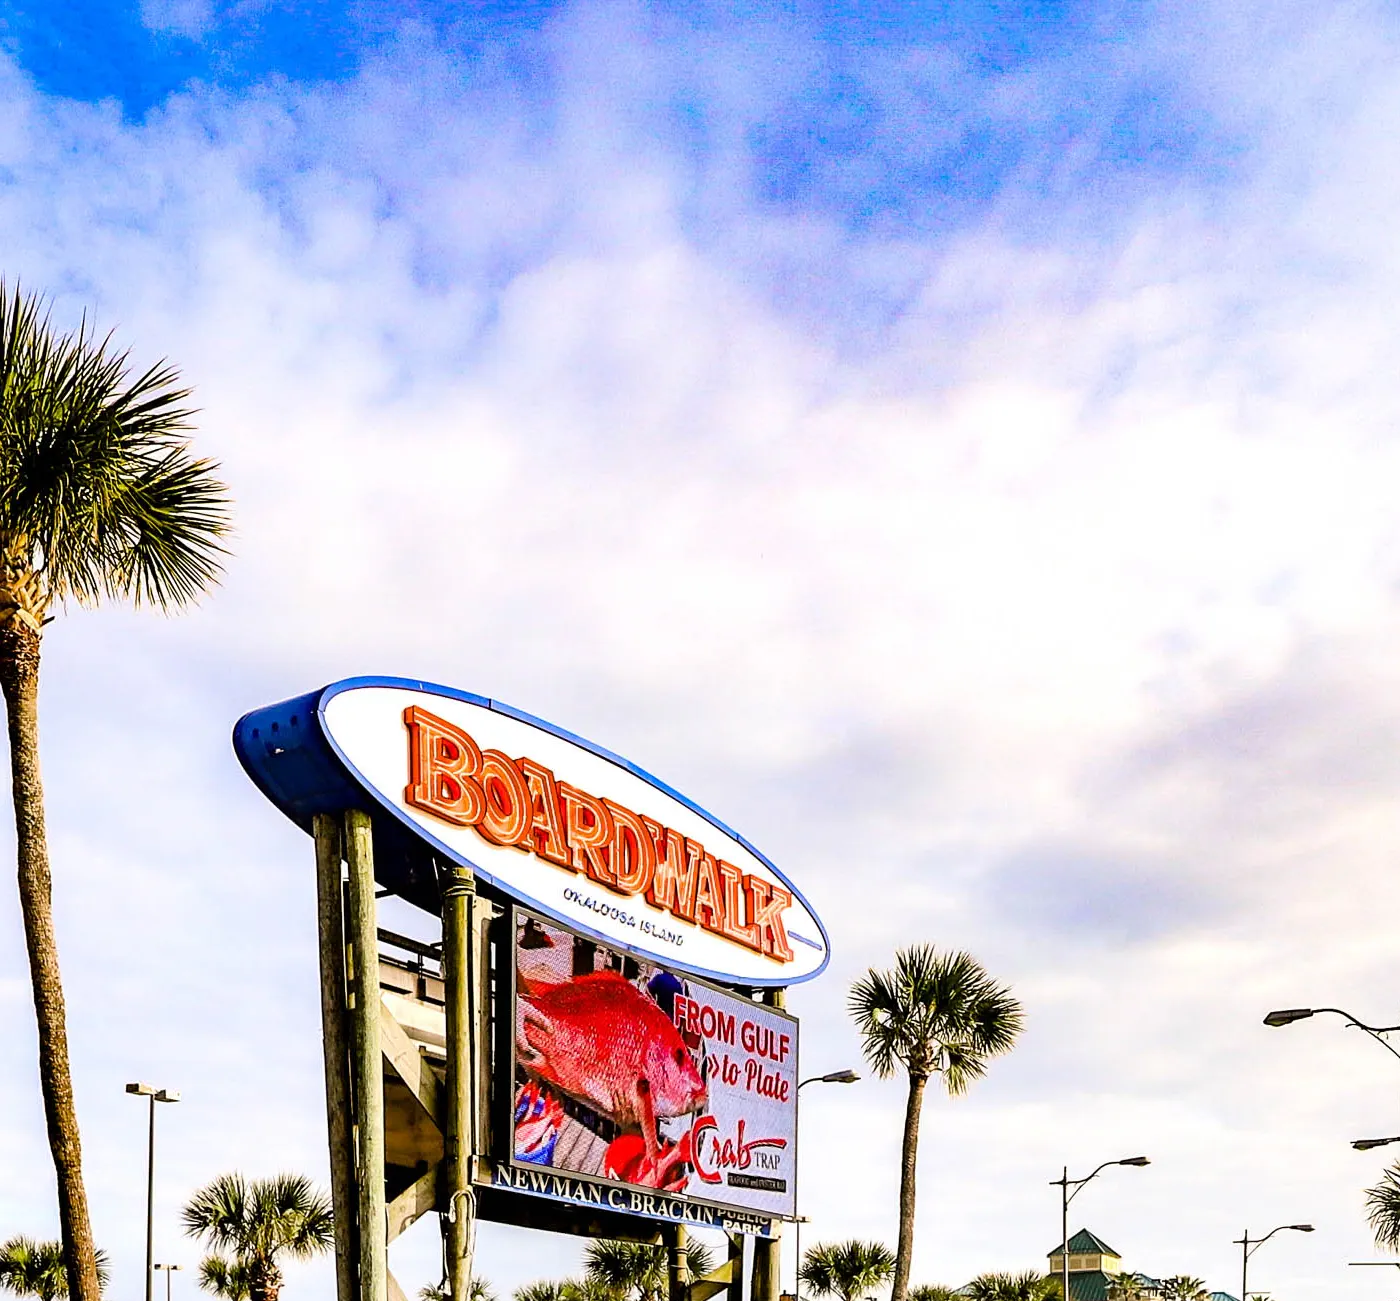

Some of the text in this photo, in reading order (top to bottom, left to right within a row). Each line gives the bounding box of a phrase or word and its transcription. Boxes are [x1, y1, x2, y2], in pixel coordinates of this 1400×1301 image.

[403, 703, 794, 963] BOARDWALK
[563, 887, 684, 946] OKALOOSA ISLAND
[673, 993, 790, 1063] FROM GULF
[722, 1054, 789, 1102] to Plate
[691, 1115, 787, 1184] Crab
[754, 1151, 781, 1170] TRAP
[495, 1164, 714, 1225] NEWMAN C. BRACKIN
[717, 1208, 770, 1225] PUBLIC
[722, 1219, 763, 1236] PARK
